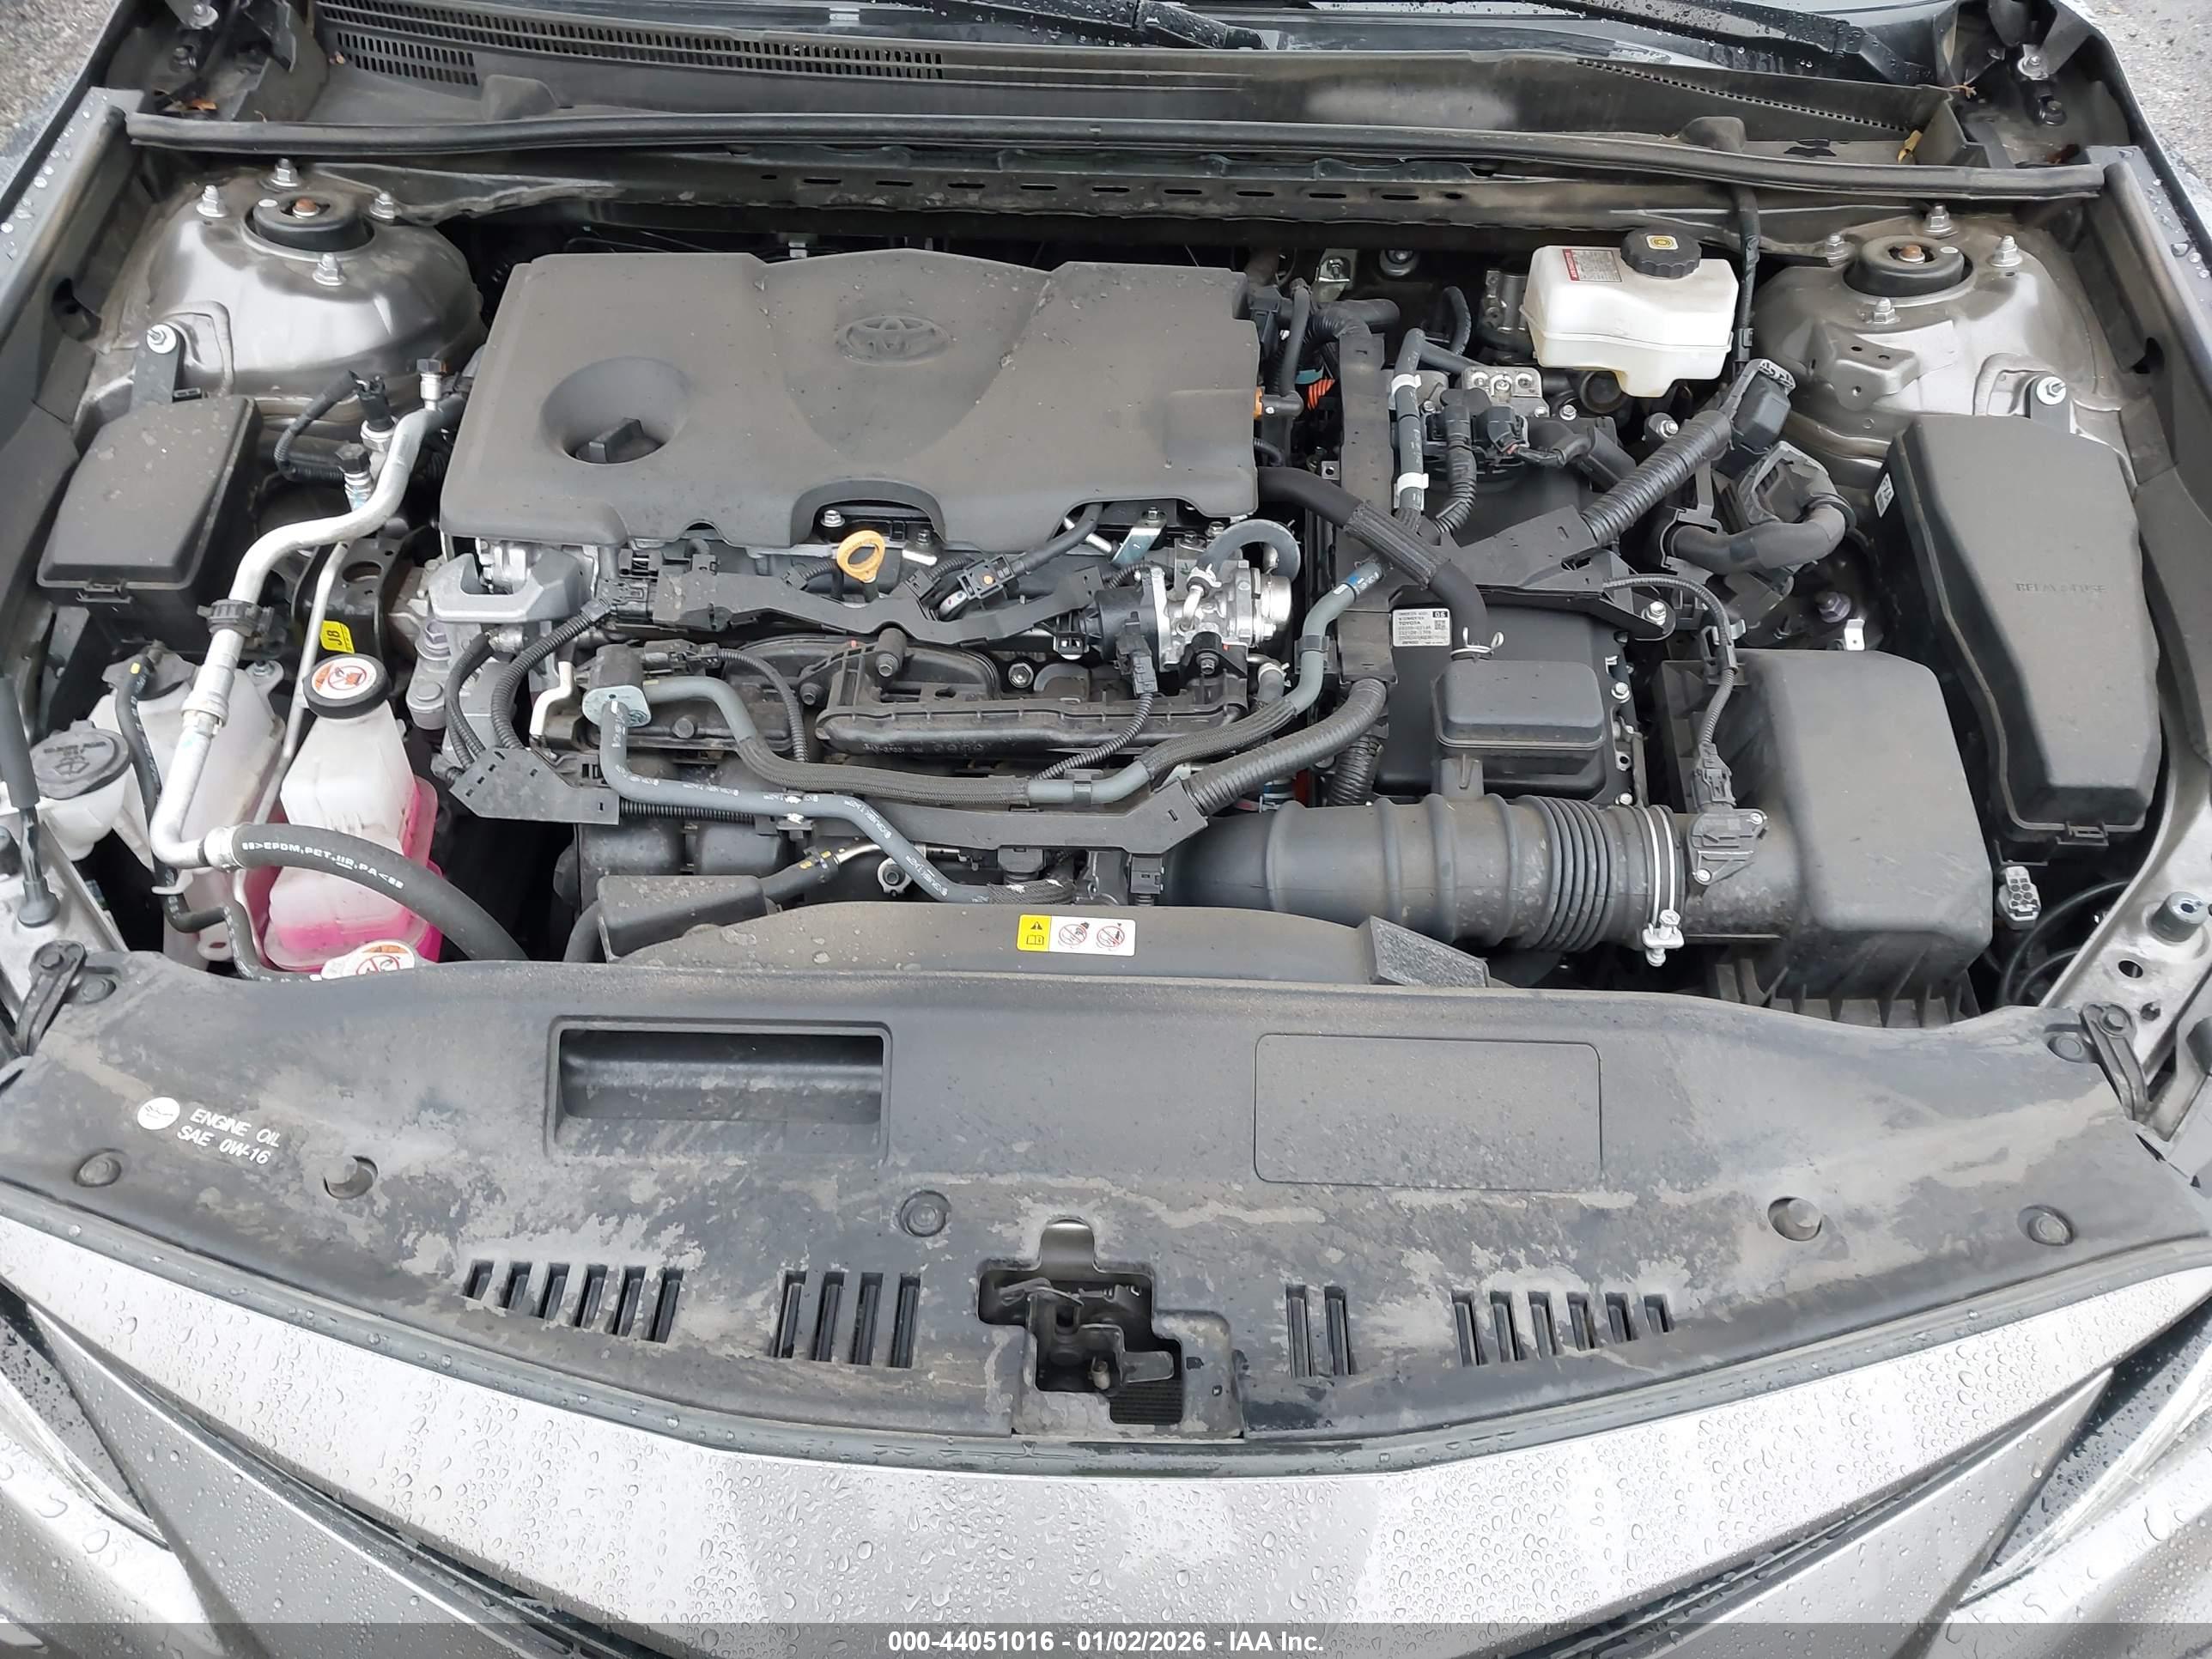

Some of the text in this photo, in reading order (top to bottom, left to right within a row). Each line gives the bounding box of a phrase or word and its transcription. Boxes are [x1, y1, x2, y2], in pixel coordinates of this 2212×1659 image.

[177, 1125, 271, 1164] SAE 0W-16
[189, 1108, 281, 1148] ENGINE OIL
